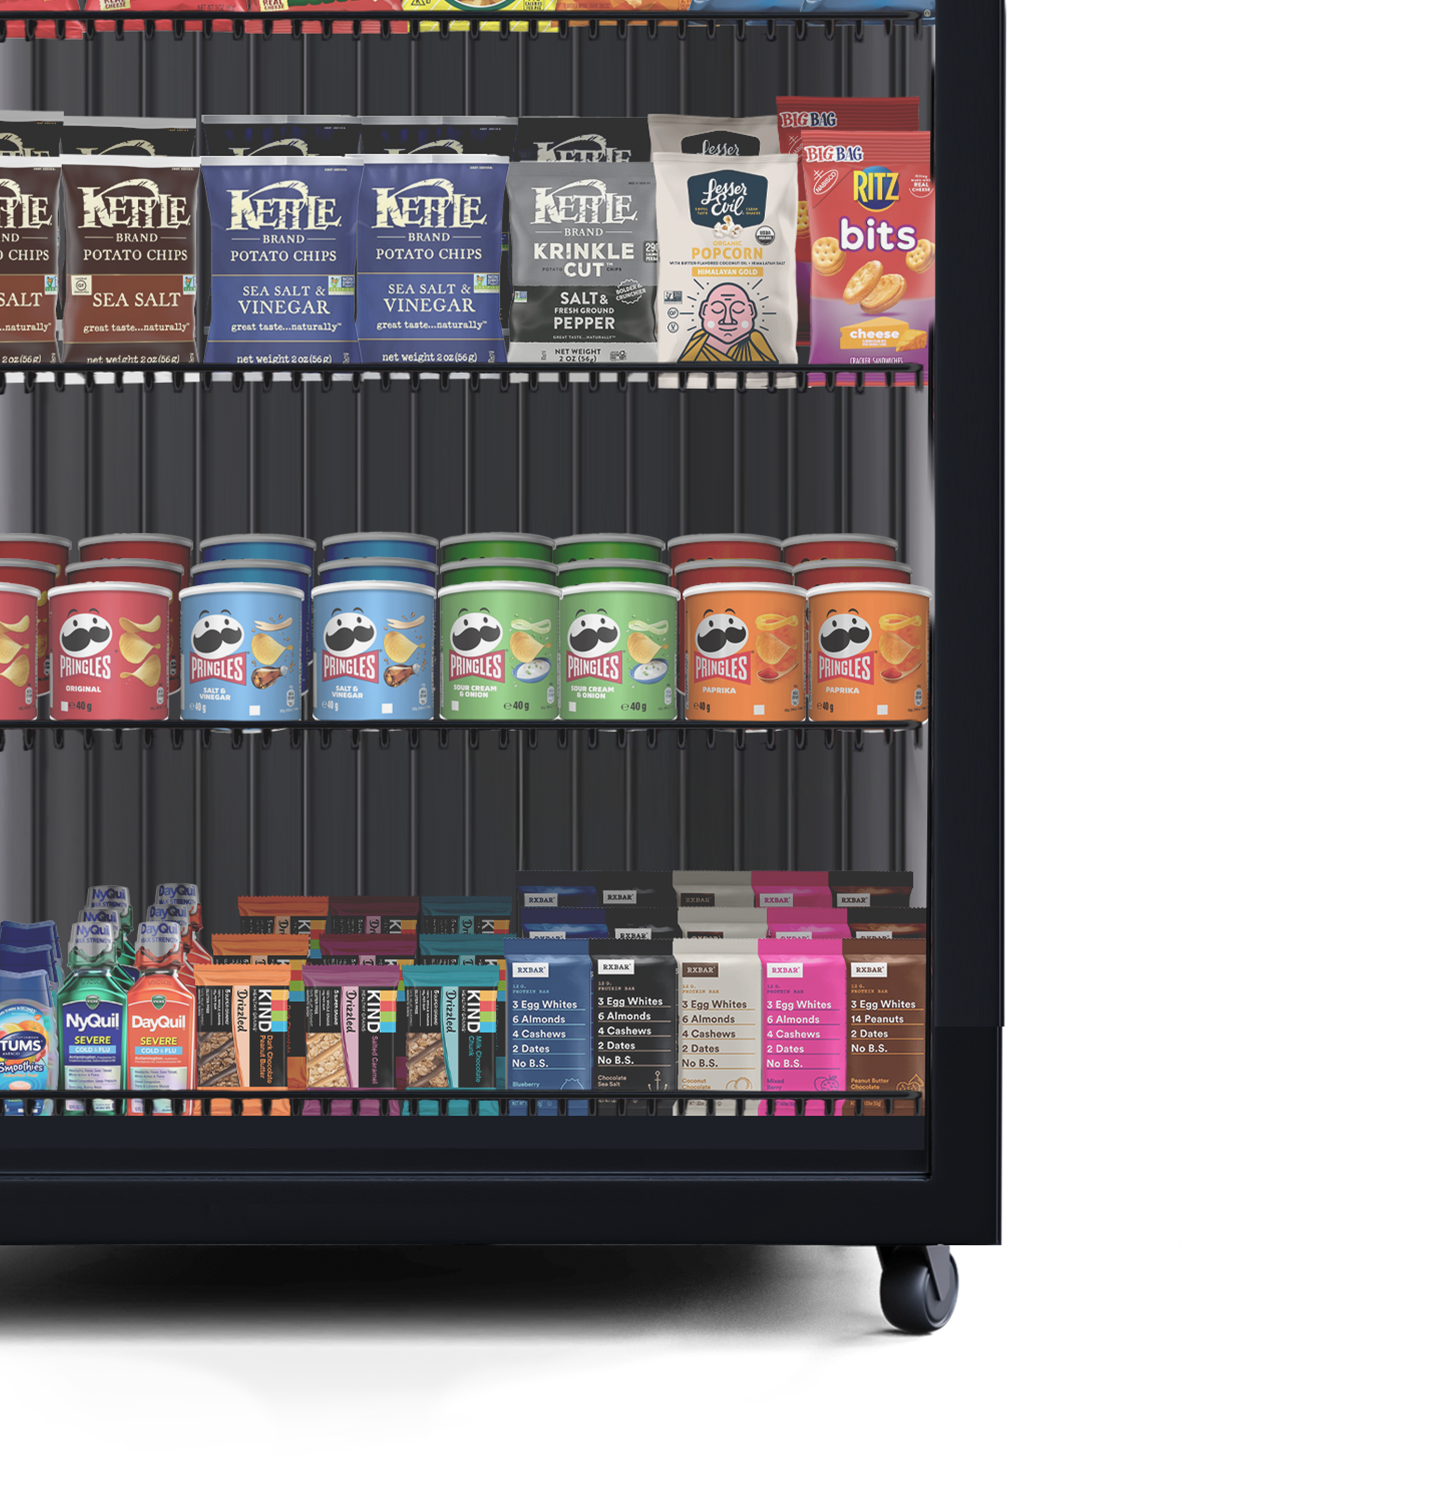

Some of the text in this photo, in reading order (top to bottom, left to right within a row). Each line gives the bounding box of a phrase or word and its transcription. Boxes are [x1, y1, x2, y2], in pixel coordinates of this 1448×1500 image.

[703, 180, 747, 204] Lesser
[853, 170, 900, 203] RITZ
[529, 175, 638, 224] KETTLE
[711, 197, 744, 215] Evil
[839, 218, 916, 252] bits
[533, 243, 635, 259] KRINKLE
[691, 246, 763, 261] POPCORN
[564, 262, 604, 276] CUT
[561, 292, 608, 306] SALT &
[554, 316, 615, 330] PEPPER
[695, 655, 748, 680] PRINGLES
[346, 989, 356, 1033] Drizzled
[851, 1015, 904, 1023] 14 Peanuts
[132, 1014, 185, 1032] DayQuil
[140, 1037, 177, 1045] SEVERE
[851, 1030, 888, 1038] 2 Dates
[851, 1045, 887, 1053] No B.S.
